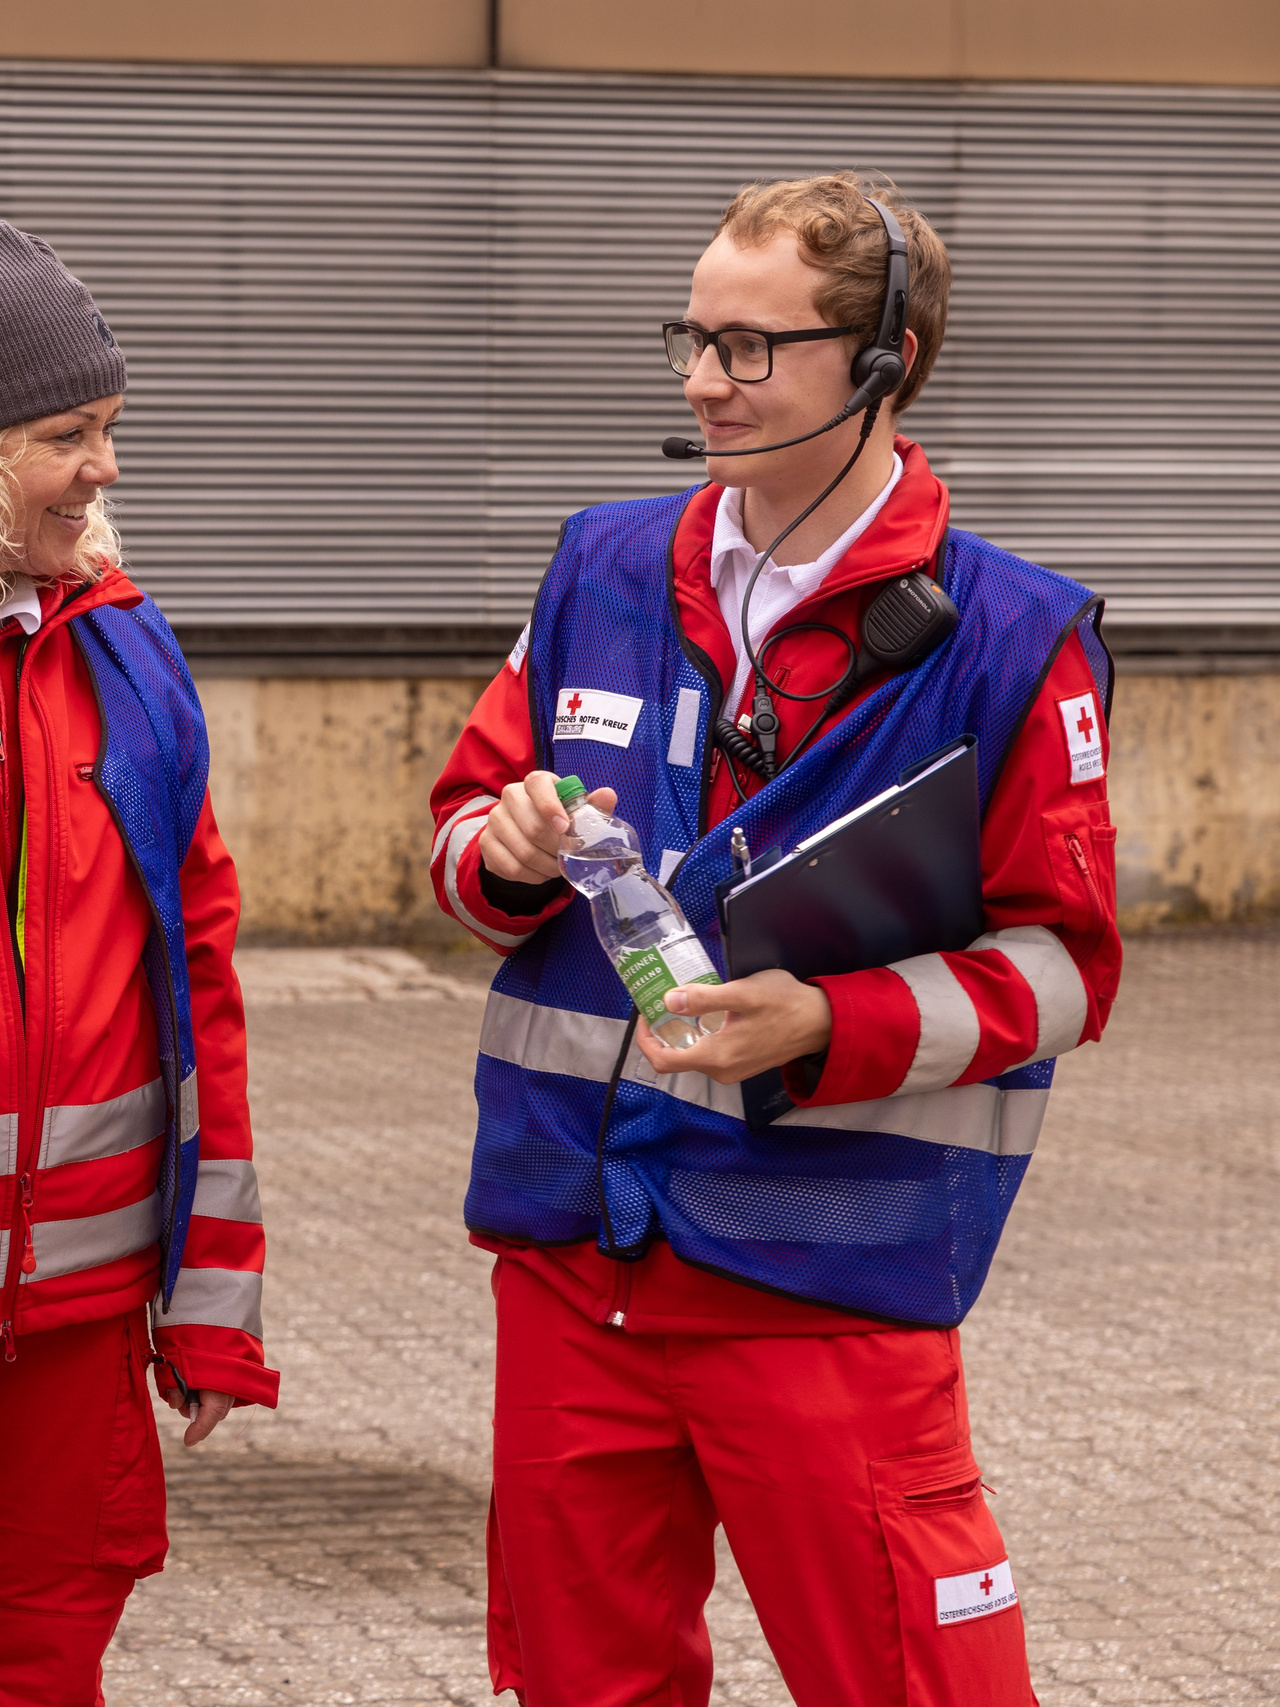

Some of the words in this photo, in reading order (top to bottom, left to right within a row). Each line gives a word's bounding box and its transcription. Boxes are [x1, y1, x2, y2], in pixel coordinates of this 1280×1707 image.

[907, 587, 931, 613] MOTOROLA
[579, 715, 600, 725] ROTES
[602, 718, 629, 731] KREUZ
[939, 1602, 994, 1620] ÖSTERREICHISCHES
